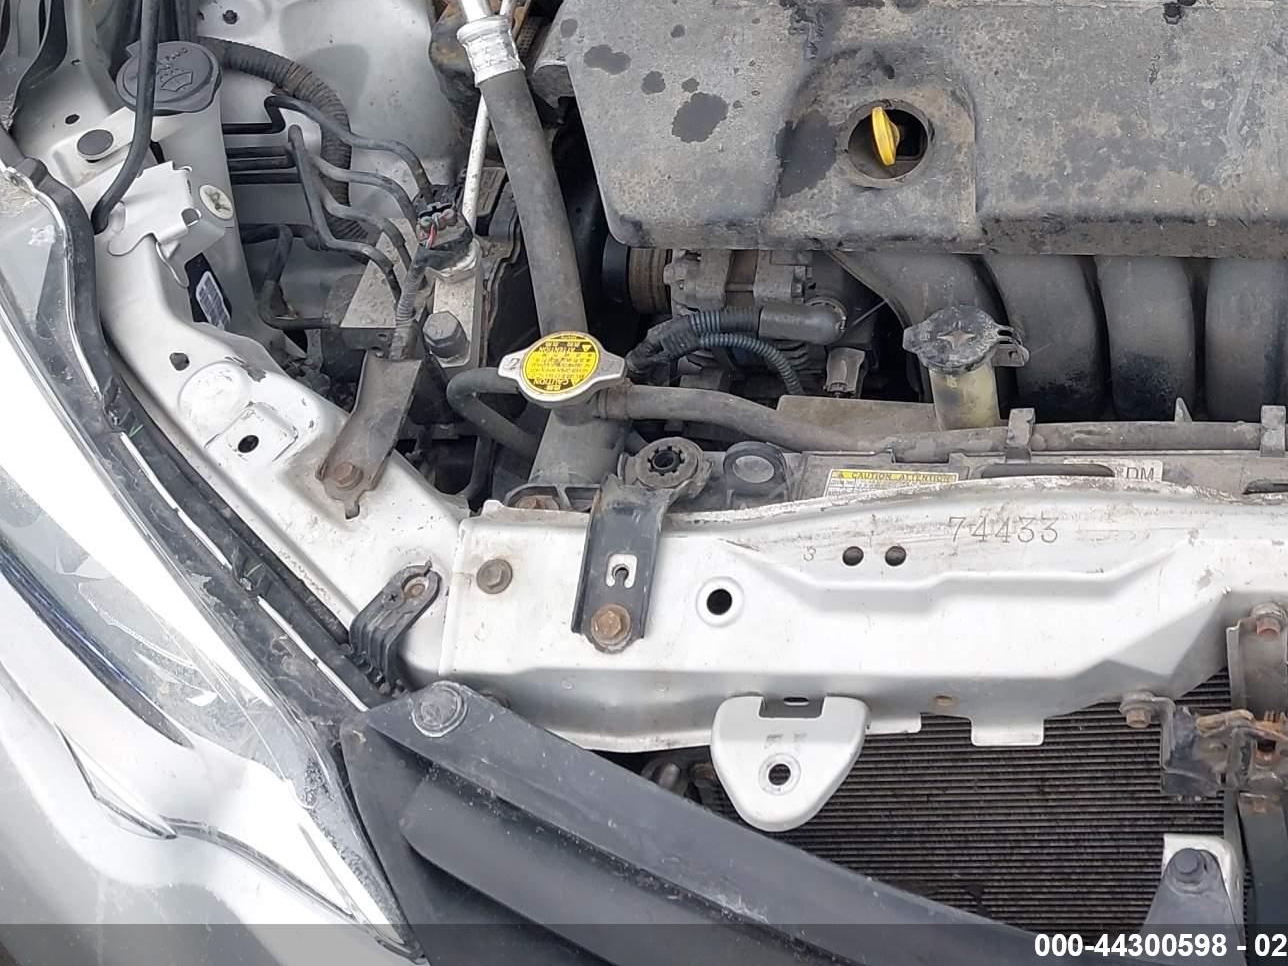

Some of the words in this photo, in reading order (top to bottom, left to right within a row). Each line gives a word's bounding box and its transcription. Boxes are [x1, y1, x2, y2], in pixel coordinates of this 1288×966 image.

[533, 378, 569, 386] CAUTION
[850, 472, 891, 480] CAUTION
[948, 516, 1060, 544] 74433
